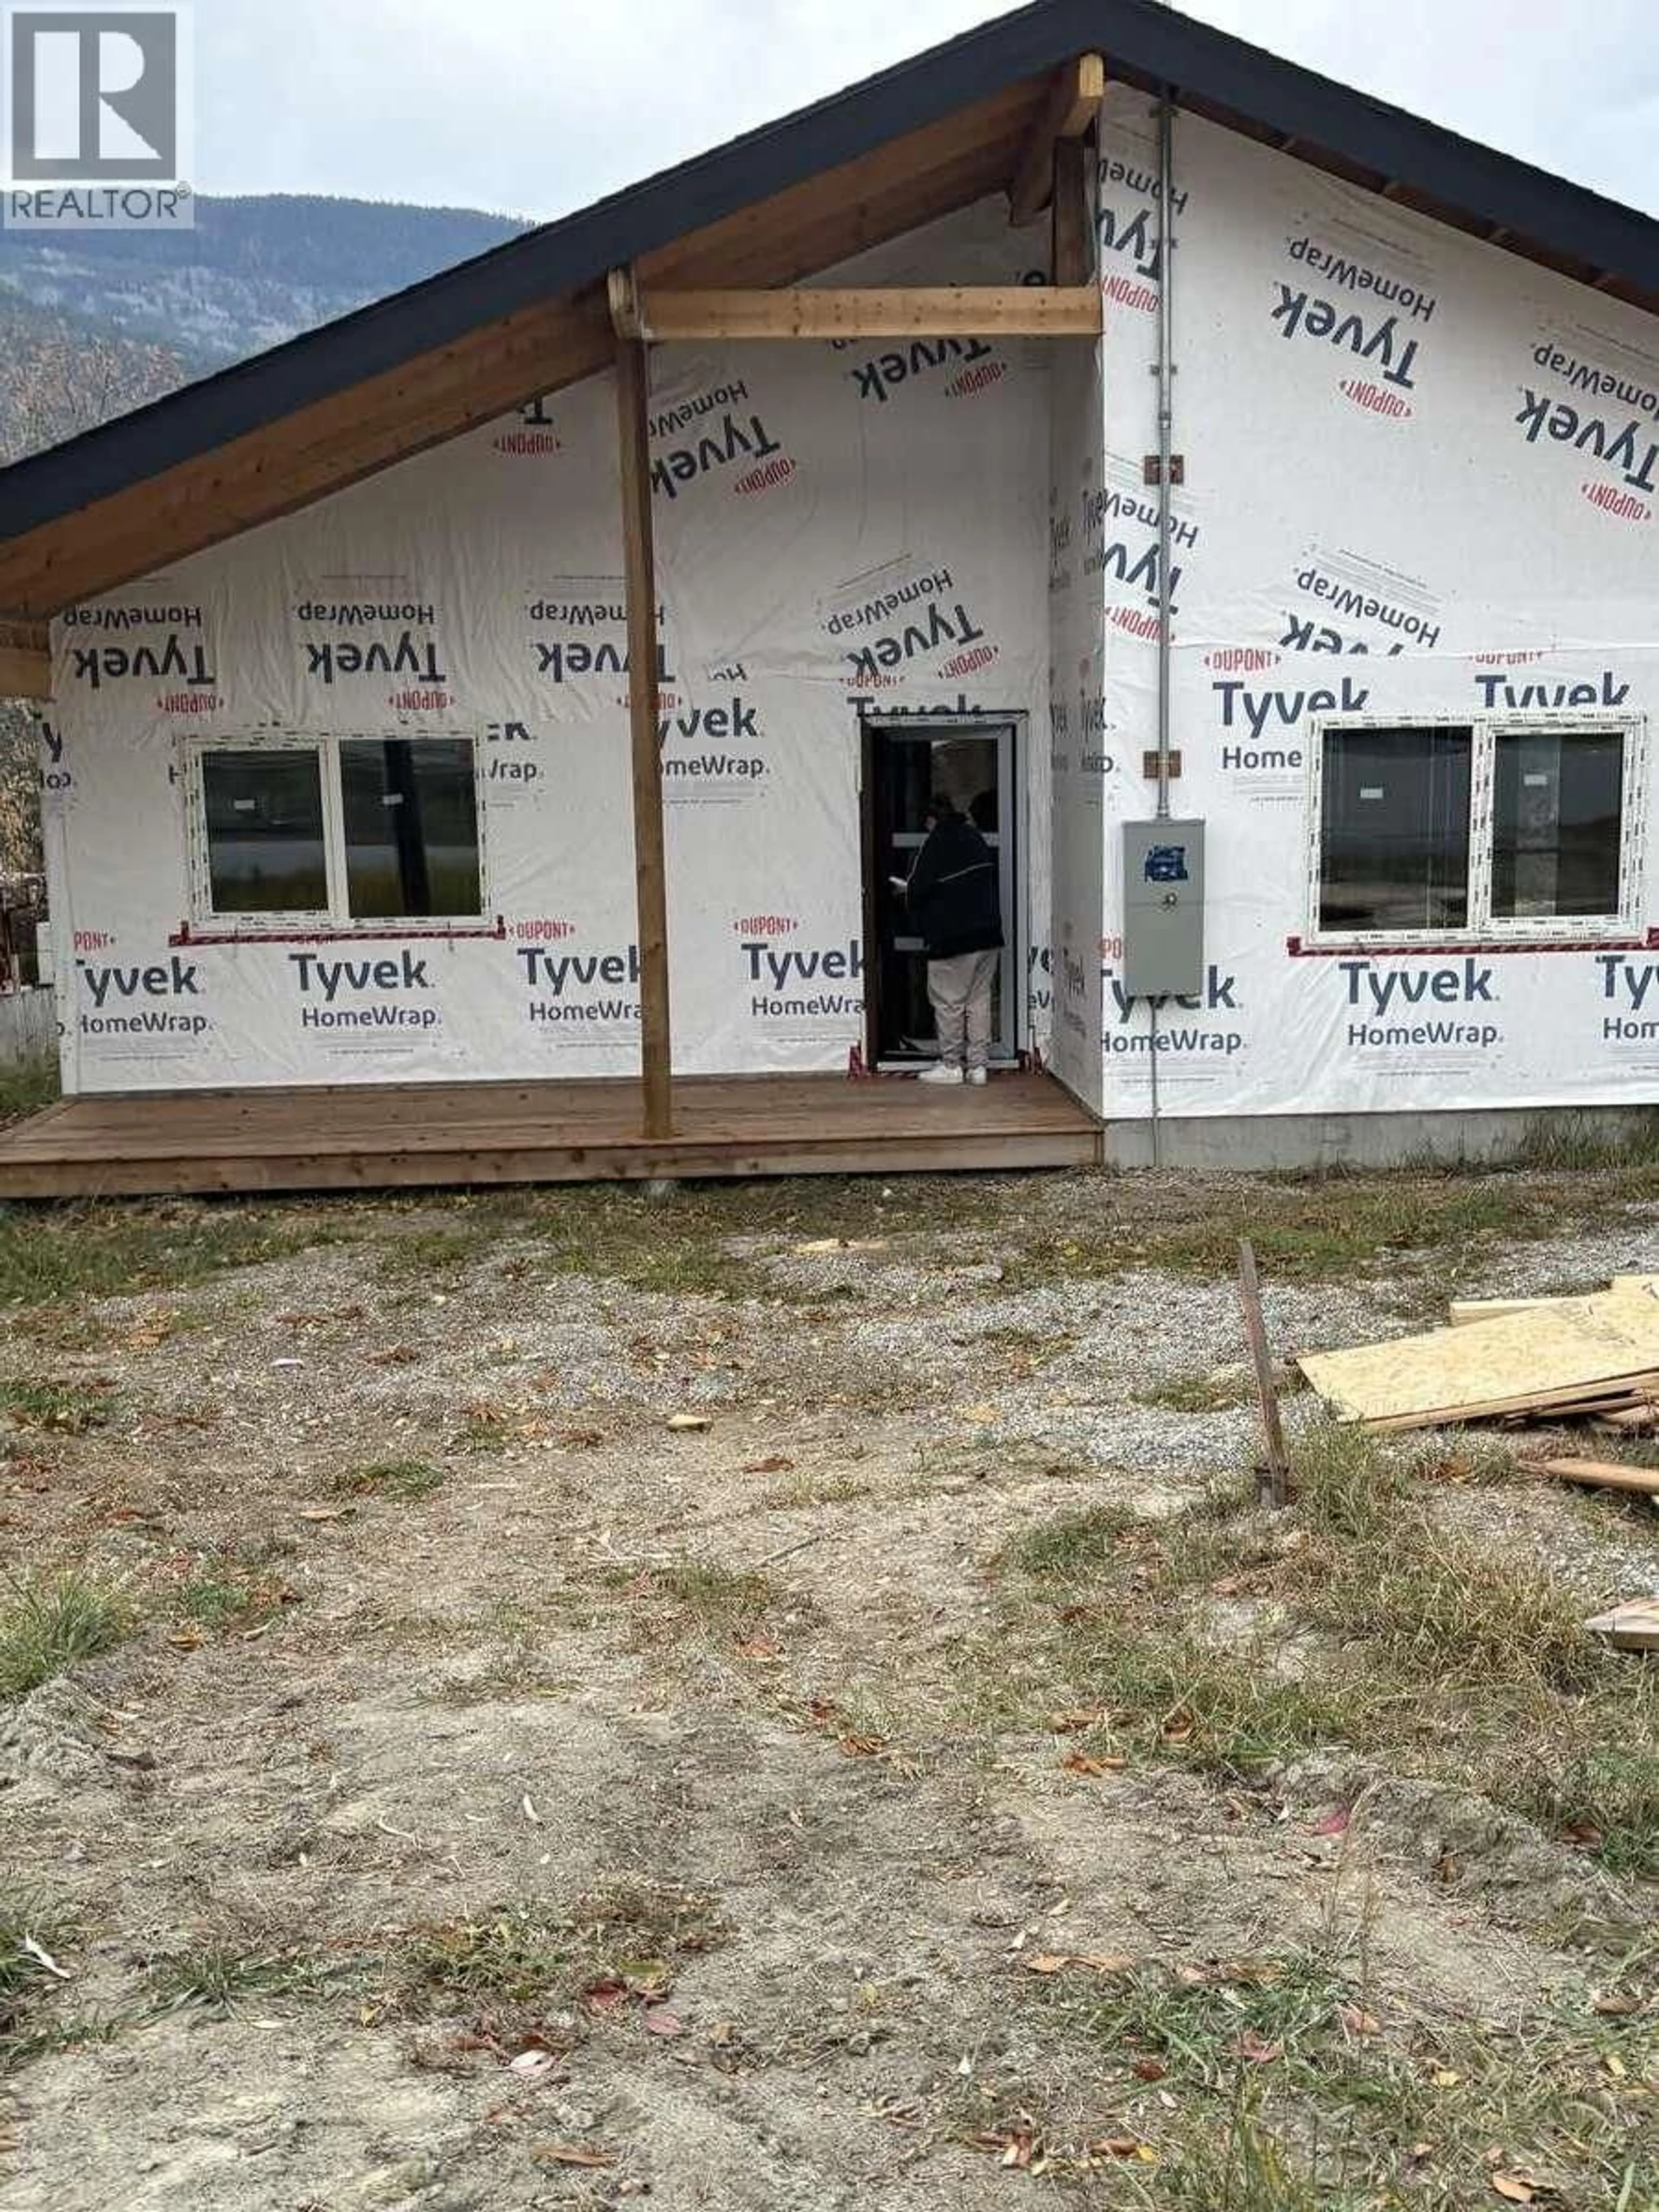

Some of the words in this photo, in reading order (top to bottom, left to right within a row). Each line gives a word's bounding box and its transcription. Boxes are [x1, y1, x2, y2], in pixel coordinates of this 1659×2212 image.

[1271, 284, 1419, 388] Tyvek
[1345, 380, 1406, 417] DUPONT
[1534, 343, 1659, 420] omeWrap
[501, 433, 554, 455] DUPONT
[1515, 389, 1659, 493] Tyvek
[1588, 483, 1644, 520] DUPONT
[1109, 605, 1166, 646] UPONT
[1297, 569, 1441, 648] HomeWrap
[74, 634, 215, 689] Tyvek
[308, 631, 446, 683] Tyvek
[1212, 648, 1271, 672] DUPONT
[395, 691, 447, 711] DUPONT
[1212, 677, 1370, 739] Tyvek
[660, 754, 764, 778] meWrap
[516, 922, 567, 940] DUPONT
[741, 916, 792, 936] DUPONT
[76, 956, 199, 1007] yvek
[288, 949, 427, 1001] Tyvek
[1338, 958, 1493, 1016] Tyvek
[1595, 954, 1659, 1011] Ty
[1348, 1021, 1498, 1048] HomeWrap
